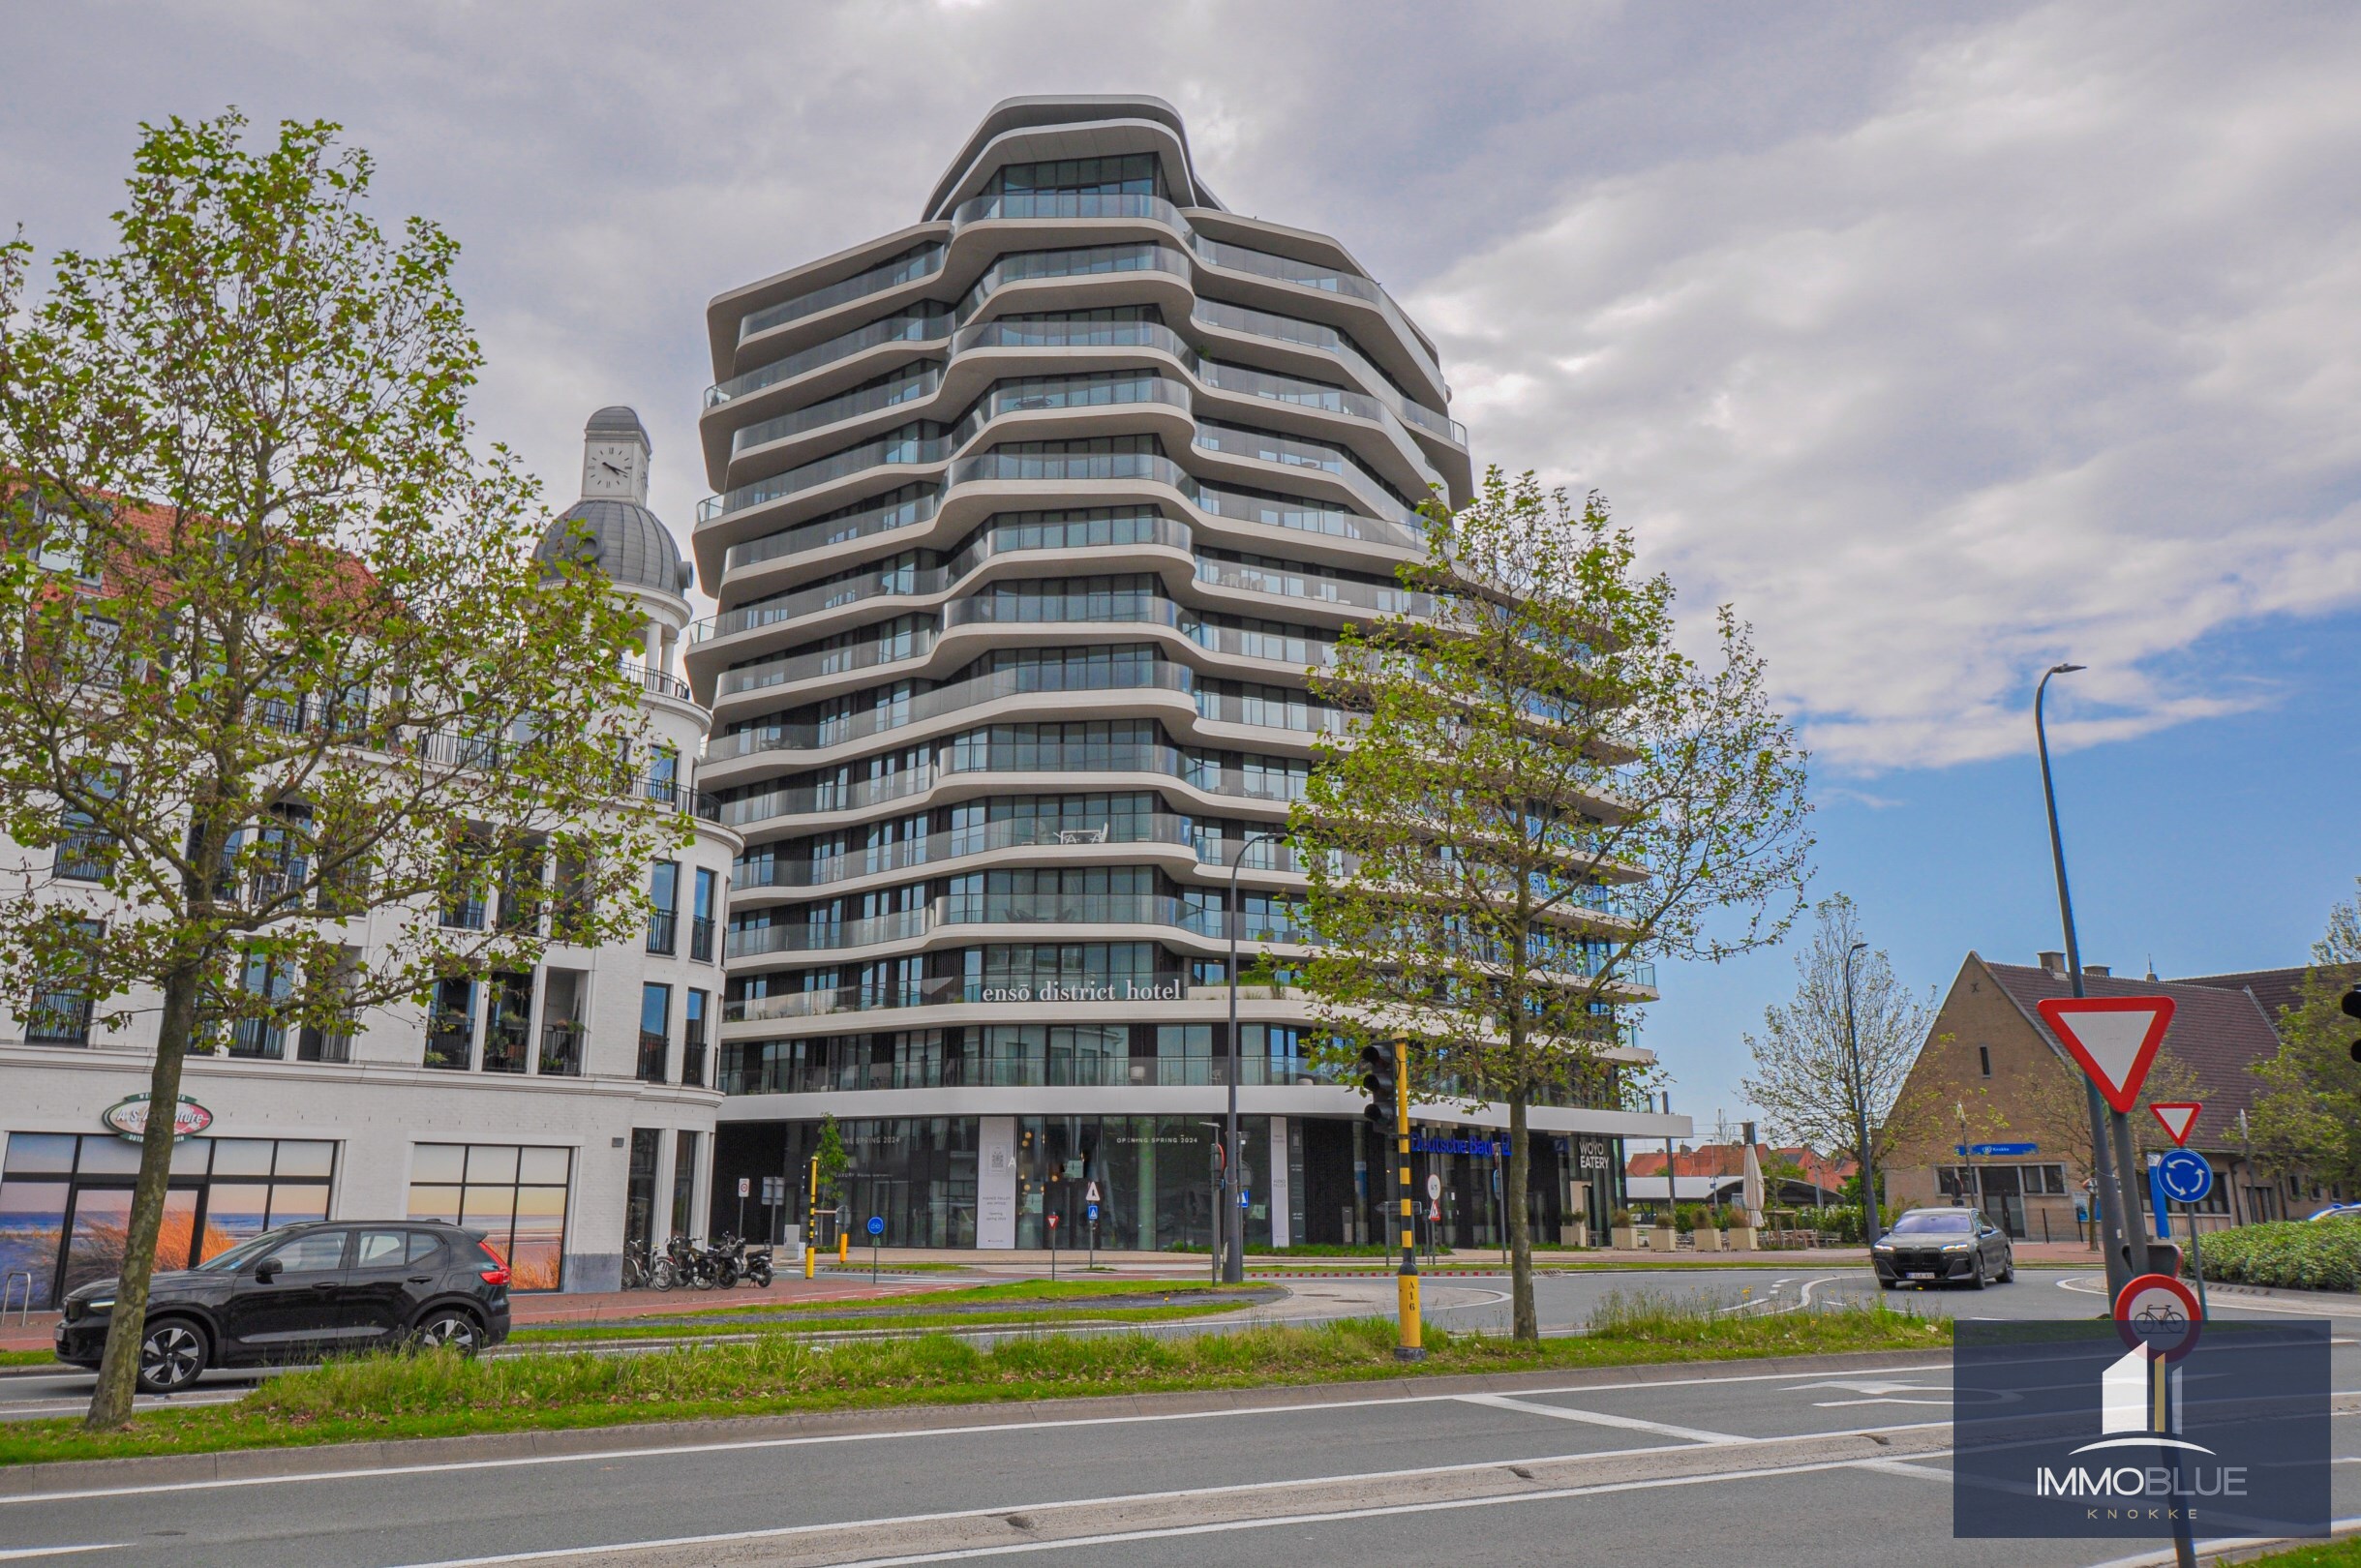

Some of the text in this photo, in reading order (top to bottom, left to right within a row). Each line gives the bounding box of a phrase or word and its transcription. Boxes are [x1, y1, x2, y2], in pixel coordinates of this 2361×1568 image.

[983, 980, 1181, 1002] ensō district hotel
[1410, 1132, 1468, 1154] Deutsche
[1579, 1142, 1604, 1156] WOYO
[1580, 1155, 1610, 1169] EATERY
